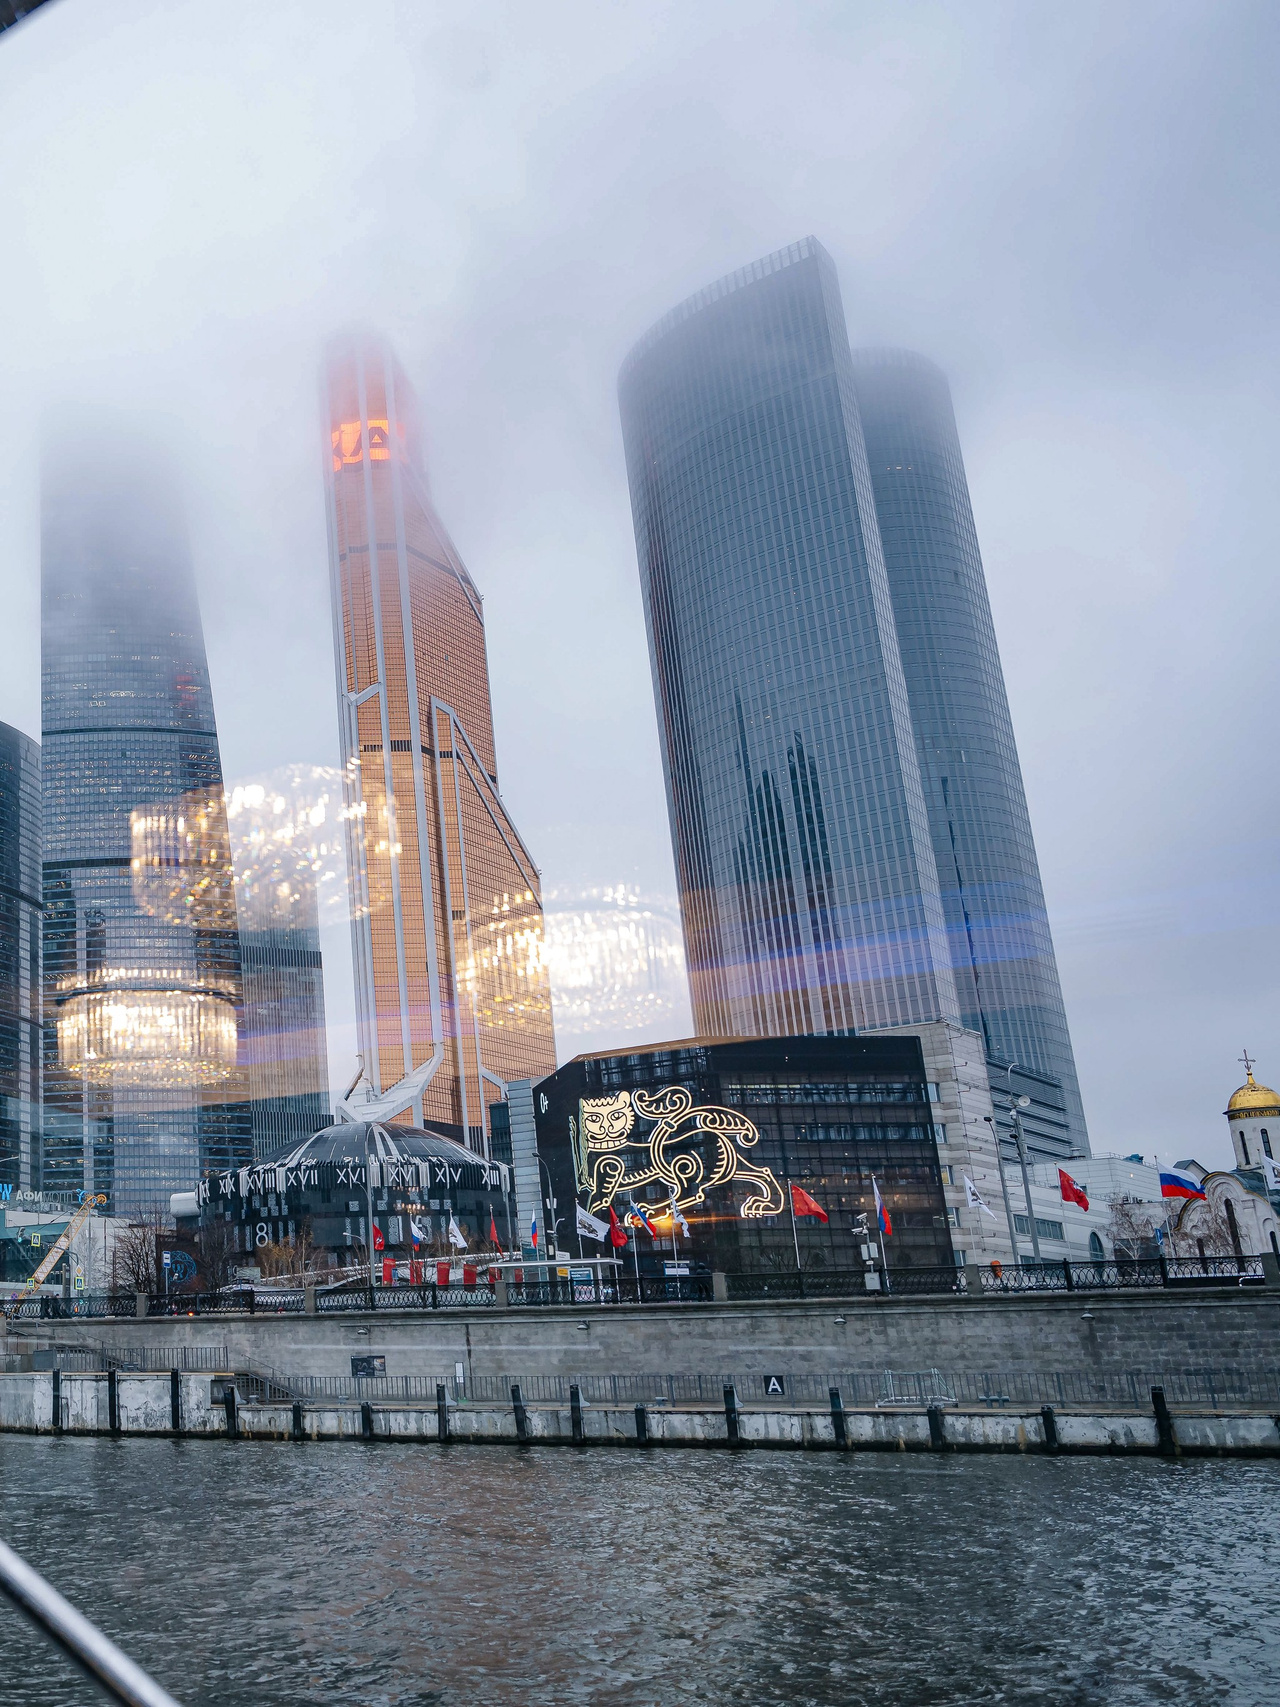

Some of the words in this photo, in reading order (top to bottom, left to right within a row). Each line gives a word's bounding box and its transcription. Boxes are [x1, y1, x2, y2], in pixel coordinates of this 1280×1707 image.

[287, 1169, 319, 1187] XVII
[336, 1167, 366, 1184] XVI
[480, 1169, 500, 1186] XIII
[256, 1222, 269, 1248] 8
